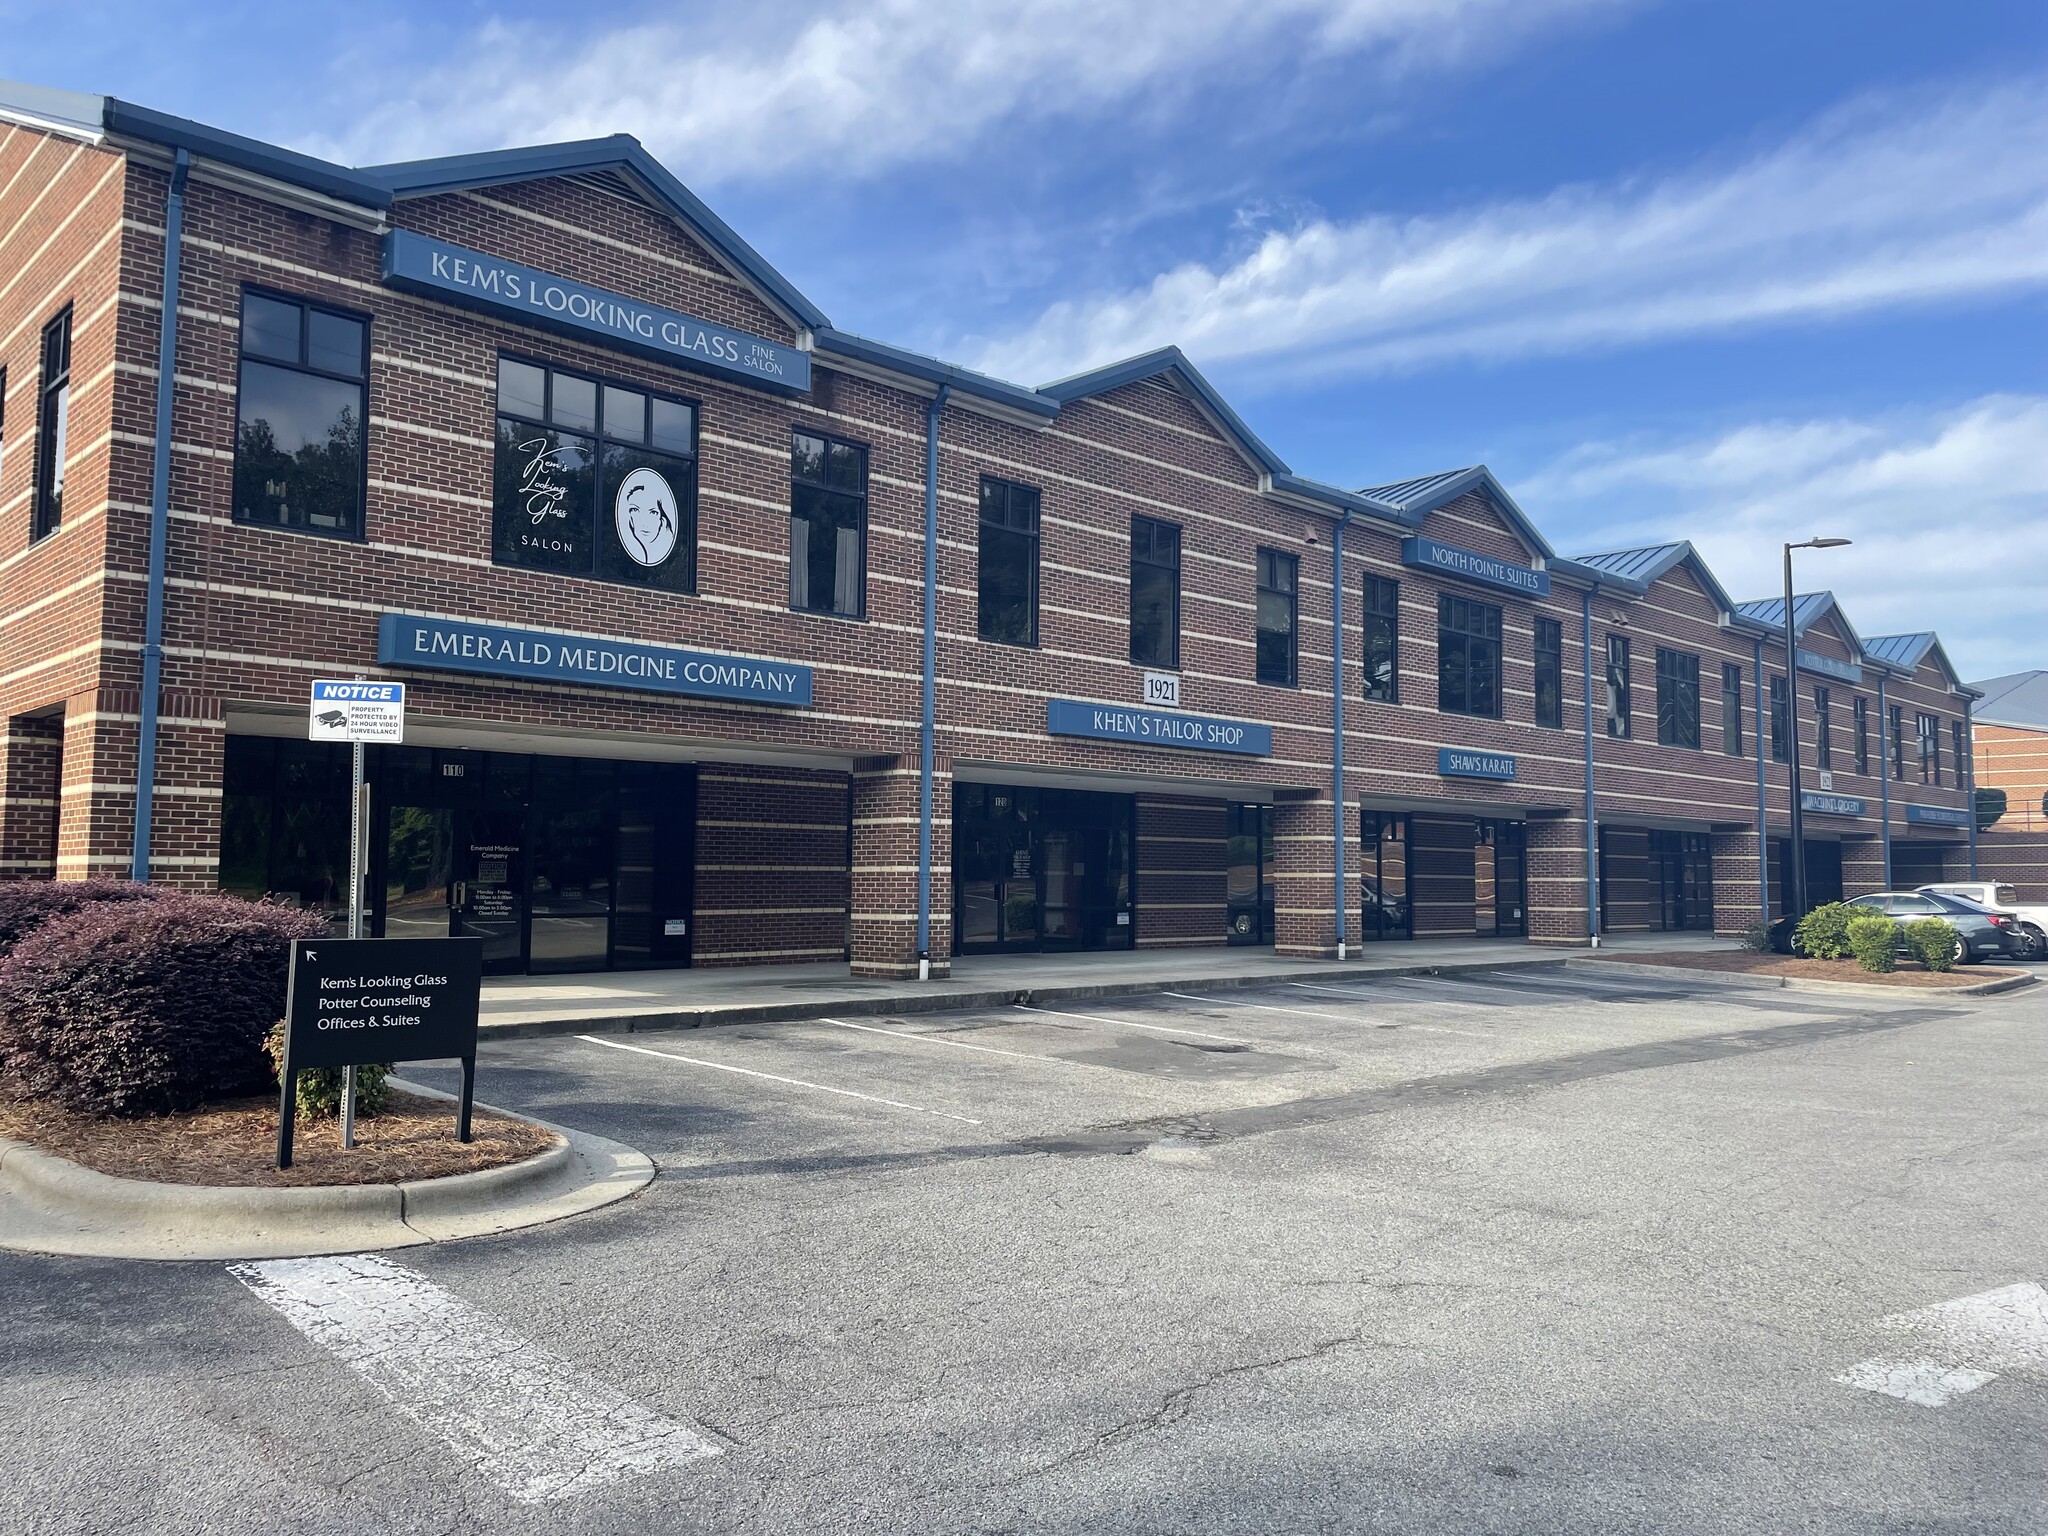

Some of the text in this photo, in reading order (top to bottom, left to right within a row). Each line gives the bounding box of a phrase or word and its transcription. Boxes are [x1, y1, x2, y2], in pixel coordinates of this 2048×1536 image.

[431, 252, 738, 363] KEM'S LOOKING GLASS
[751, 344, 775, 362] FINE
[743, 355, 783, 376] SALON
[518, 438, 588, 478] Kem's
[518, 466, 568, 499] Looking
[526, 491, 568, 524] Glass
[521, 535, 572, 553] SALON
[1432, 546, 1538, 589] NORTH POINTE SUITES
[414, 629, 797, 693] EMERALD MEDICINE COMPANY
[323, 685, 393, 700] NOTICE
[1147, 678, 1176, 701] 1921
[1093, 711, 1244, 745] KHEN'S TAILOR SHOP
[444, 765, 464, 776] 110
[1450, 754, 1514, 775] SHAW'S KARATE
[481, 852, 509, 860] Company
[320, 974, 448, 989] Kem's Looking Glass
[318, 994, 431, 1010] Potter Counseling
[317, 1015, 421, 1030] Offices & Suites
